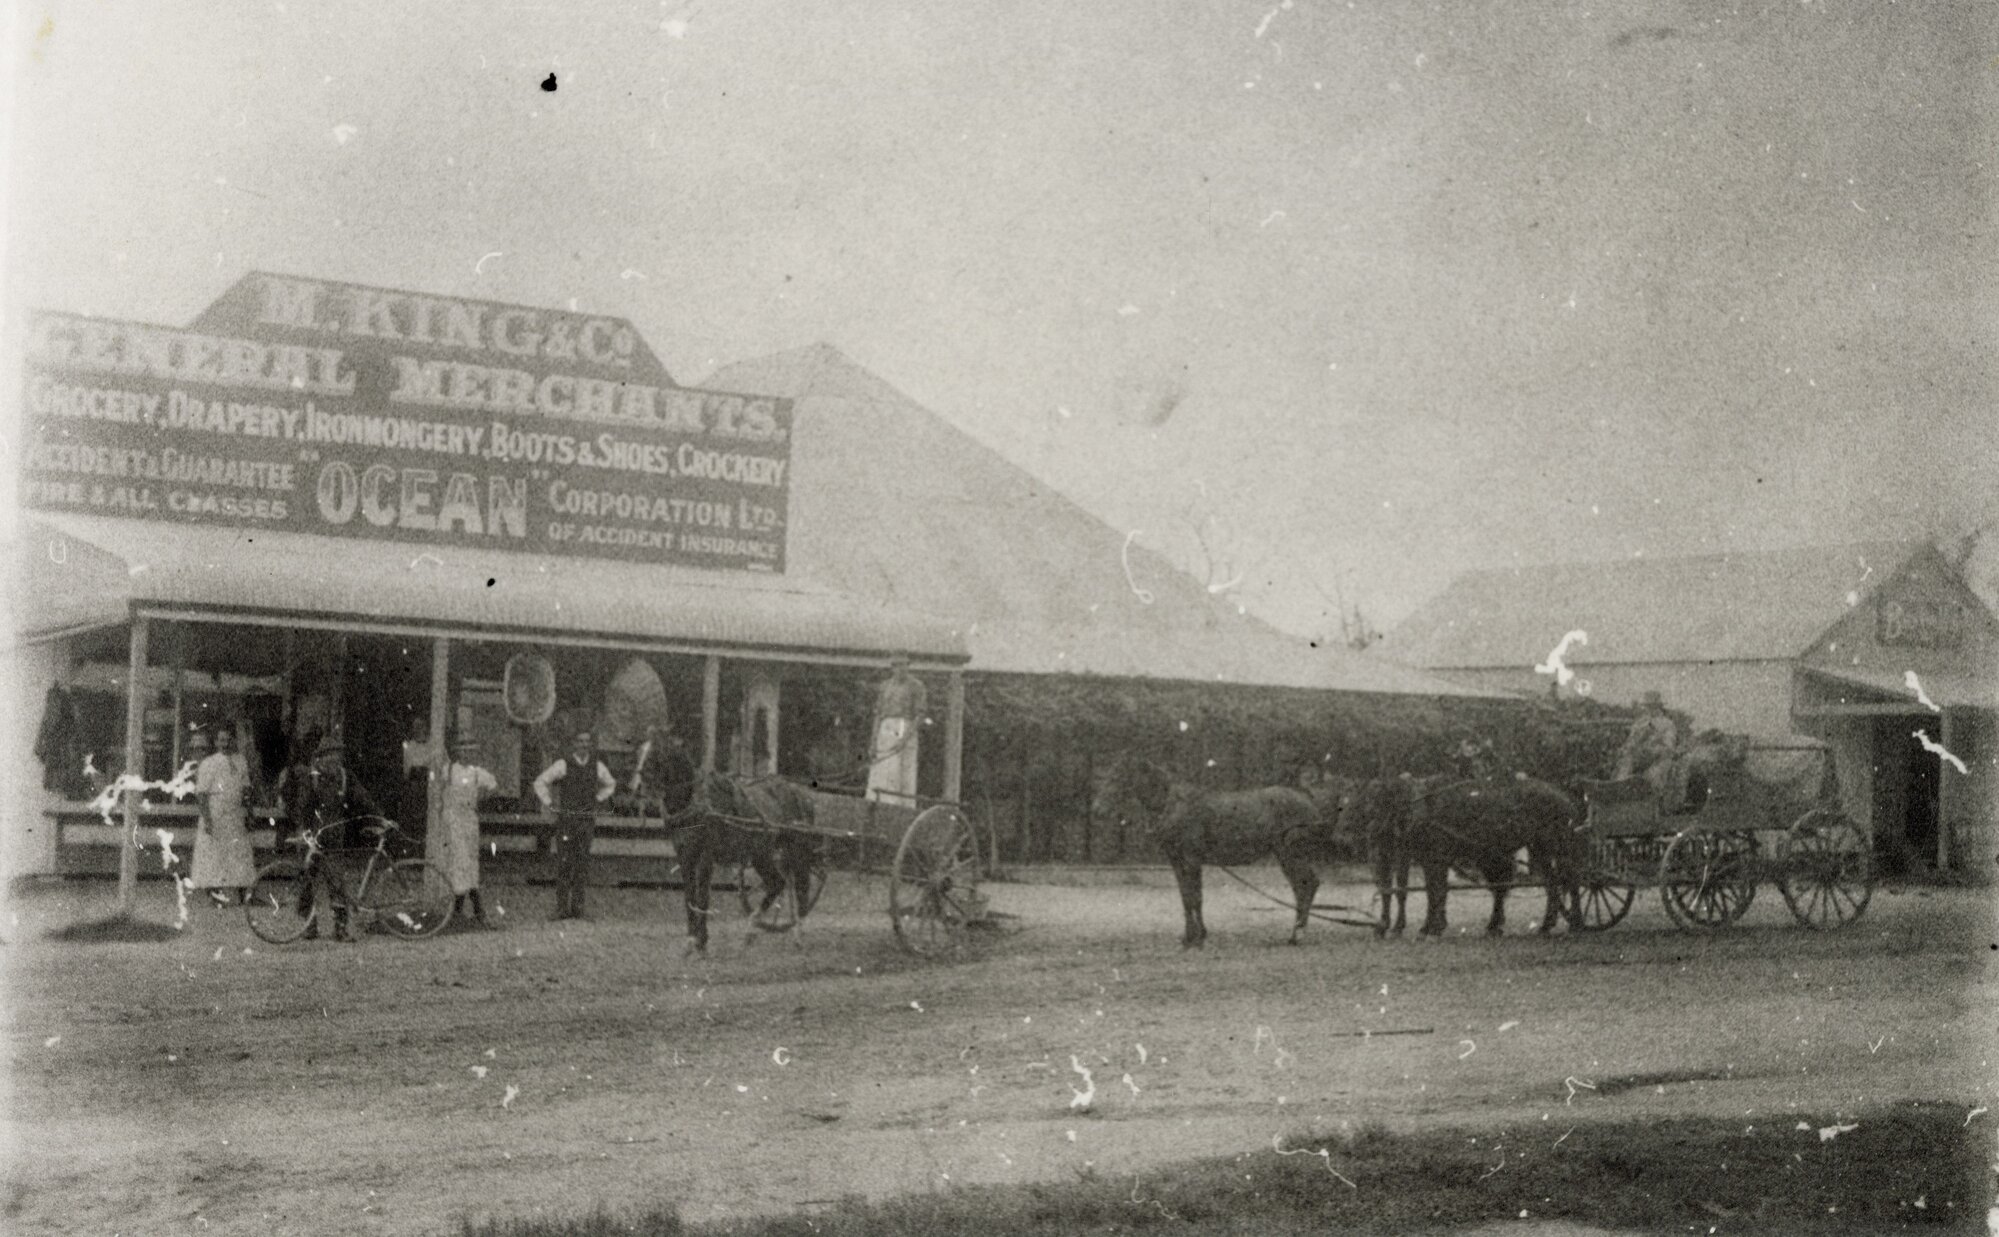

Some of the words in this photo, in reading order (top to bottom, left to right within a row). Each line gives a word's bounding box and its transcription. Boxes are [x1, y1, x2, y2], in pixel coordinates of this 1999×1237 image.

[161, 447, 295, 490] GUARANTEE
[492, 421, 575, 464] BOOTS
[577, 441, 595, 466] &
[677, 443, 787, 489] CROCKERY
[168, 490, 288, 519] CLASSES
[550, 479, 732, 529] CORPORATION
[548, 521, 576, 541] OF
[578, 524, 674, 550] ACCIDENT
